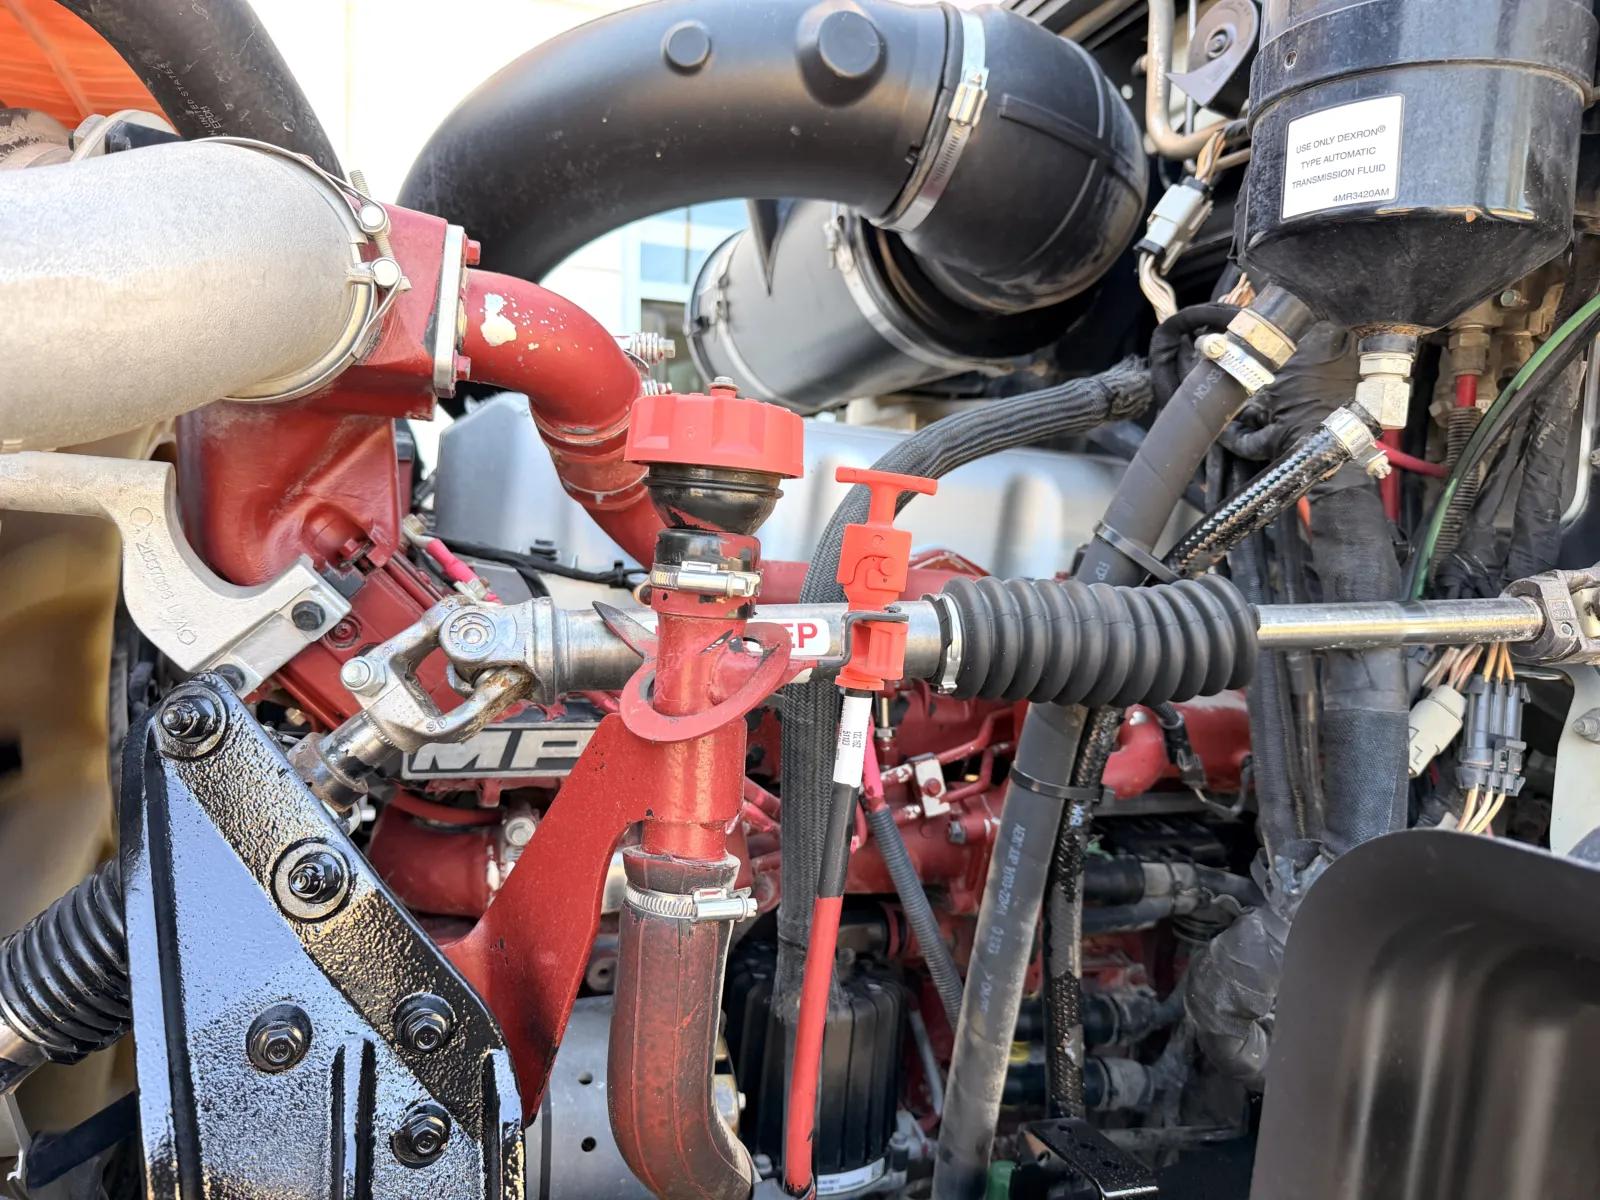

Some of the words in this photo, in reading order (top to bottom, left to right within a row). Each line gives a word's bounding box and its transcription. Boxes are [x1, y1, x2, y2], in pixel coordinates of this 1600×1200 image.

[1296, 143, 1312, 154] USE
[1313, 136, 1336, 149] ONLY
[1301, 157, 1322, 170] TYPE
[1323, 146, 1377, 163] AUTOMATIC
[1292, 168, 1355, 190] TRANSMISSION
[1357, 163, 1386, 175] FLUID
[1333, 188, 1390, 202] 4MR3420AM
